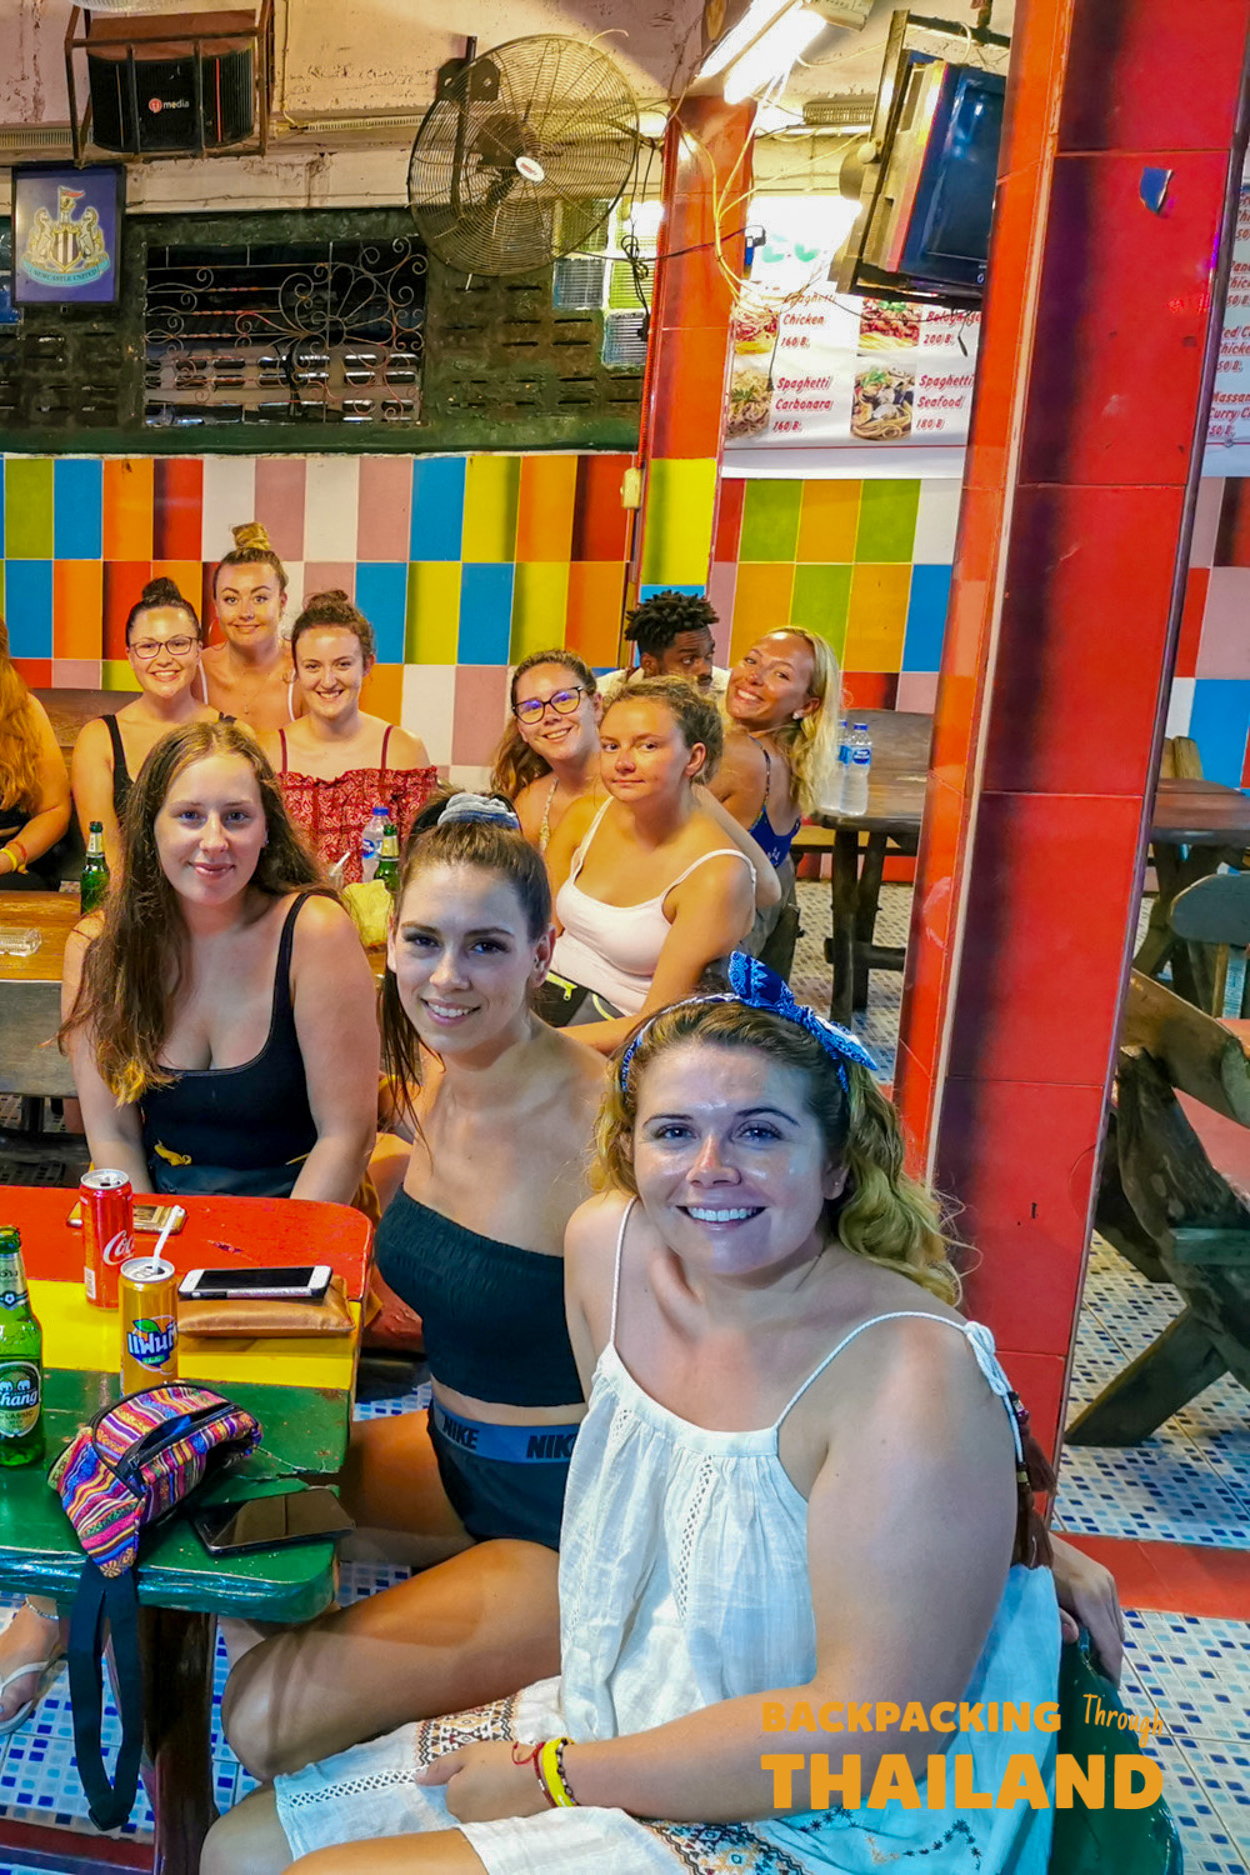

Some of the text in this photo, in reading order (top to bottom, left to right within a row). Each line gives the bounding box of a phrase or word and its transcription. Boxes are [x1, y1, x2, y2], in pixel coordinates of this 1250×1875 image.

[783, 313, 825, 325] Chicken
[923, 334, 942, 344] 200
[777, 376, 831, 392] Spaghetti
[919, 374, 974, 389] Spaghetti
[775, 398, 831, 410] Carbonara
[918, 395, 963, 407] Seafood
[773, 421, 790, 431] 160
[916, 419, 933, 429] 180
[443, 1415, 479, 1450] NIKE
[526, 1433, 578, 1459] NIK
